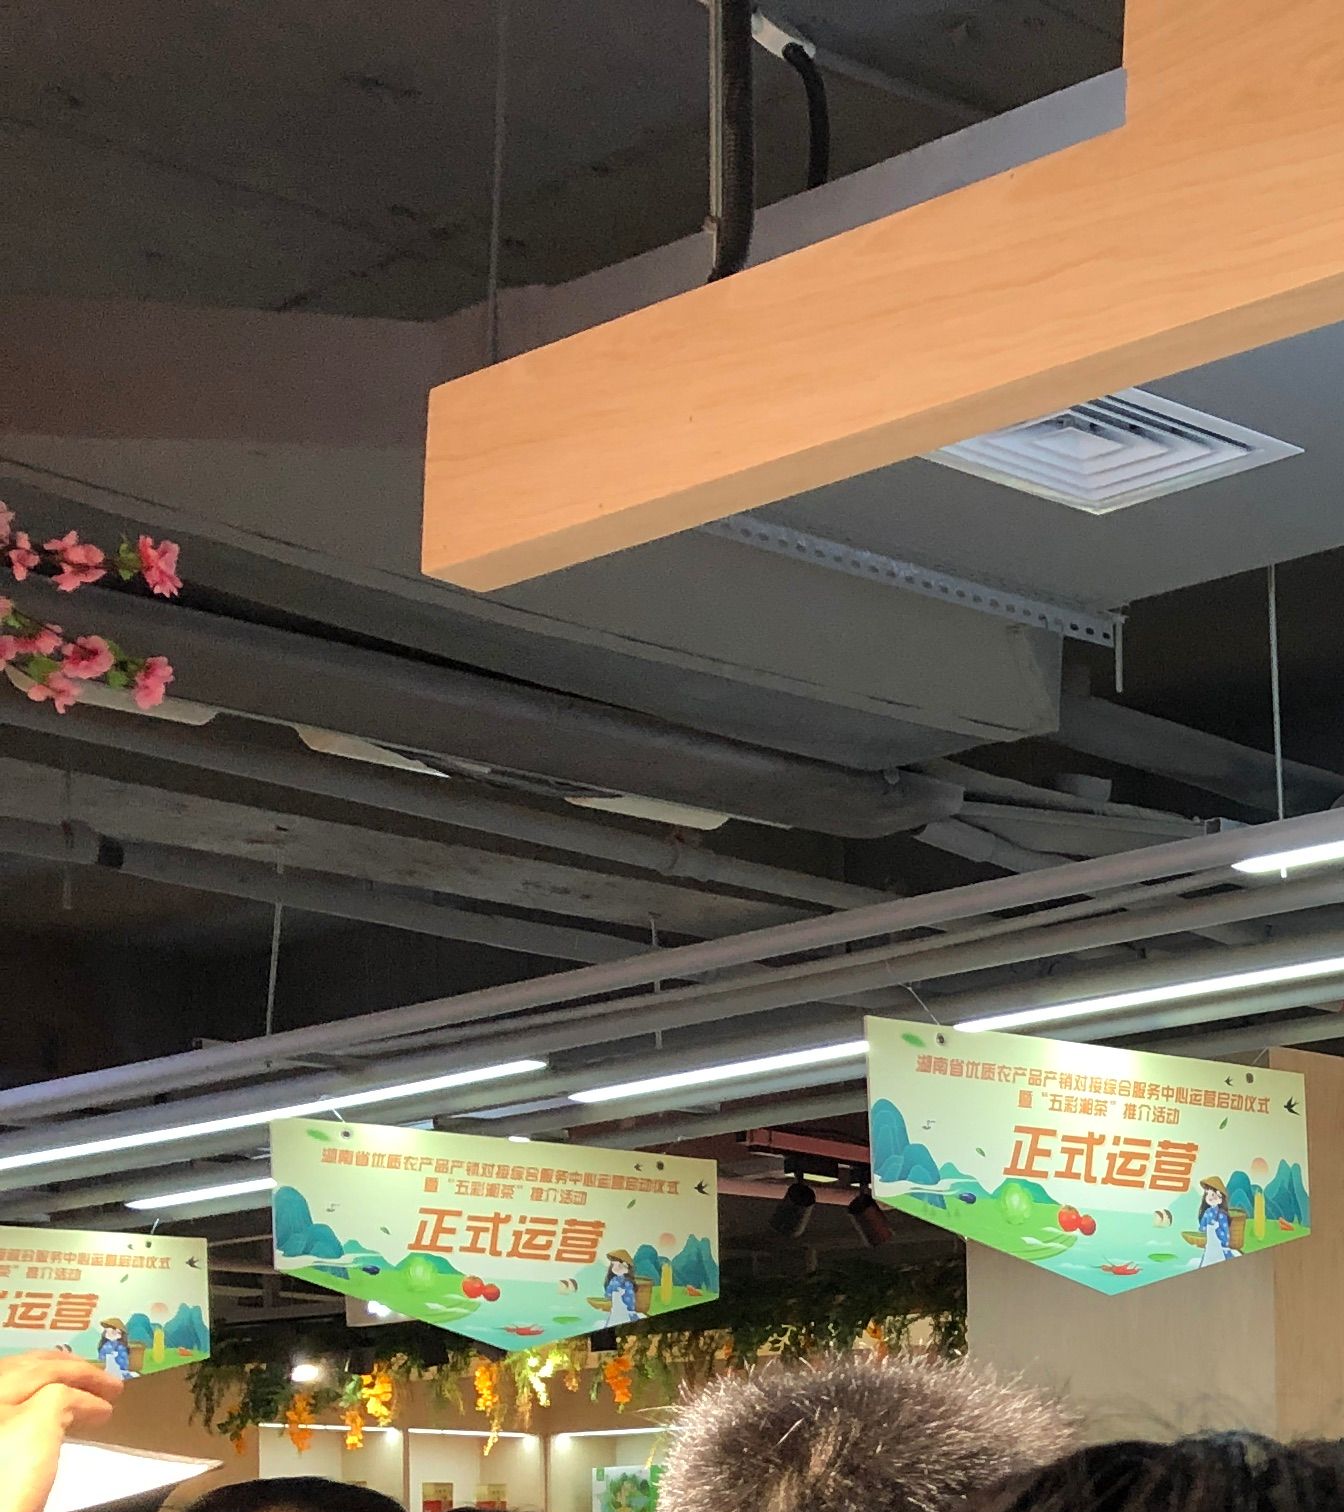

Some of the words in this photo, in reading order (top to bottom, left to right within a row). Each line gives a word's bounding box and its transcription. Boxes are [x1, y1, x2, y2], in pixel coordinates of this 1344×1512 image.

[916, 1054, 1271, 1115] 湖南省优质农产品产销对接综合服务中心运营启动仪式
[1003, 1126, 1199, 1192] 正式运营
[408, 1207, 605, 1263] 正式运营
[0, 1290, 99, 1331] 运营
